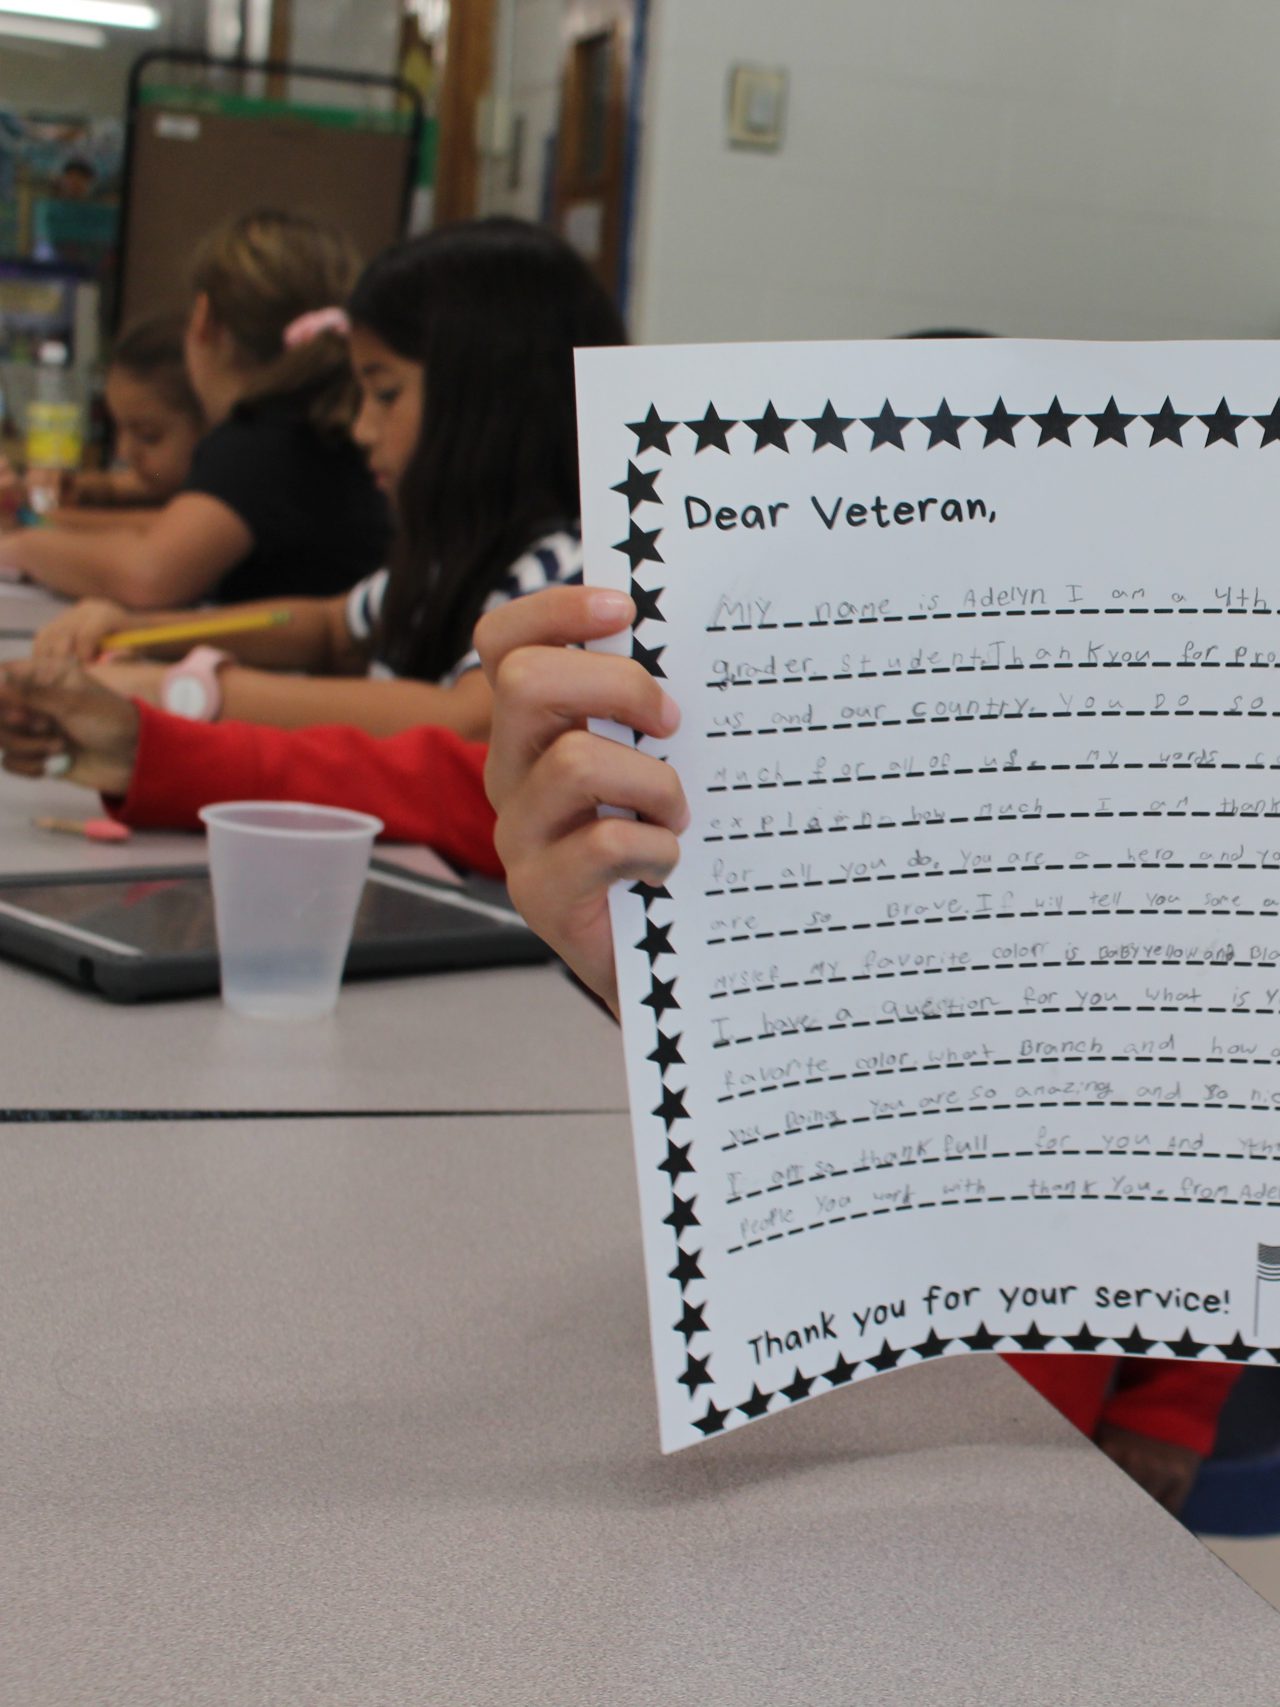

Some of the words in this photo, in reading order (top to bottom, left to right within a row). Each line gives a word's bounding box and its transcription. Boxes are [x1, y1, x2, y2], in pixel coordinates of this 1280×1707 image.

[684, 495, 790, 531] Dear
[810, 495, 997, 529] Veteran,
[815, 599, 891, 622] name
[919, 593, 940, 610] is
[963, 585, 1047, 608] Adelyn
[1065, 585, 1084, 603] I
[1112, 587, 1146, 600] am
[1171, 591, 1187, 603] a
[1215, 585, 1267, 610] 4th
[1181, 640, 1218, 662] for
[712, 711, 745, 729] us
[771, 703, 813, 725] and
[840, 702, 887, 719] our
[1231, 695, 1264, 711] so
[812, 755, 865, 780] for
[890, 755, 914, 772] all
[928, 752, 951, 770] of
[1160, 748, 1219, 765] words
[910, 805, 946, 822] how
[1098, 796, 1112, 812] I
[1150, 795, 1189, 811] am
[711, 858, 755, 884] for
[781, 861, 812, 878] all
[1007, 849, 1046, 866] are
[1075, 849, 1091, 860] a
[1127, 847, 1174, 862] hero
[1200, 844, 1244, 860] and
[710, 915, 760, 932] are
[1089, 892, 1123, 908] tell
[1204, 892, 1241, 908] some
[864, 949, 972, 977] favorite
[992, 942, 1046, 961] color
[1065, 942, 1079, 960] is
[711, 1016, 731, 1041] I
[762, 1011, 812, 1034] have
[835, 1008, 854, 1021] a
[881, 996, 1000, 1018] question
[1023, 986, 1059, 1006] for
[1075, 991, 1119, 1006] you
[1145, 987, 1203, 1003] what
[1232, 986, 1251, 1006] is
[723, 1056, 831, 1090] favorite
[927, 1043, 996, 1061] what
[1020, 1037, 1103, 1057] Branch
[1123, 1033, 1175, 1054] and
[1212, 1036, 1258, 1056] how
[919, 1090, 960, 1107] are
[1015, 1080, 1114, 1100] amazing
[1136, 1081, 1181, 1100] and
[726, 1170, 743, 1197] I
[1035, 1125, 1071, 1149] for
[1102, 1133, 1150, 1149] you
[942, 1177, 986, 1196] with
[1028, 1178, 1097, 1196] thank
[1180, 1176, 1229, 1199] from
[746, 1310, 839, 1365] Thank
[851, 1298, 907, 1338] you
[922, 1283, 982, 1316] for
[998, 1284, 1079, 1313] your
[1094, 1284, 1232, 1315] service!
